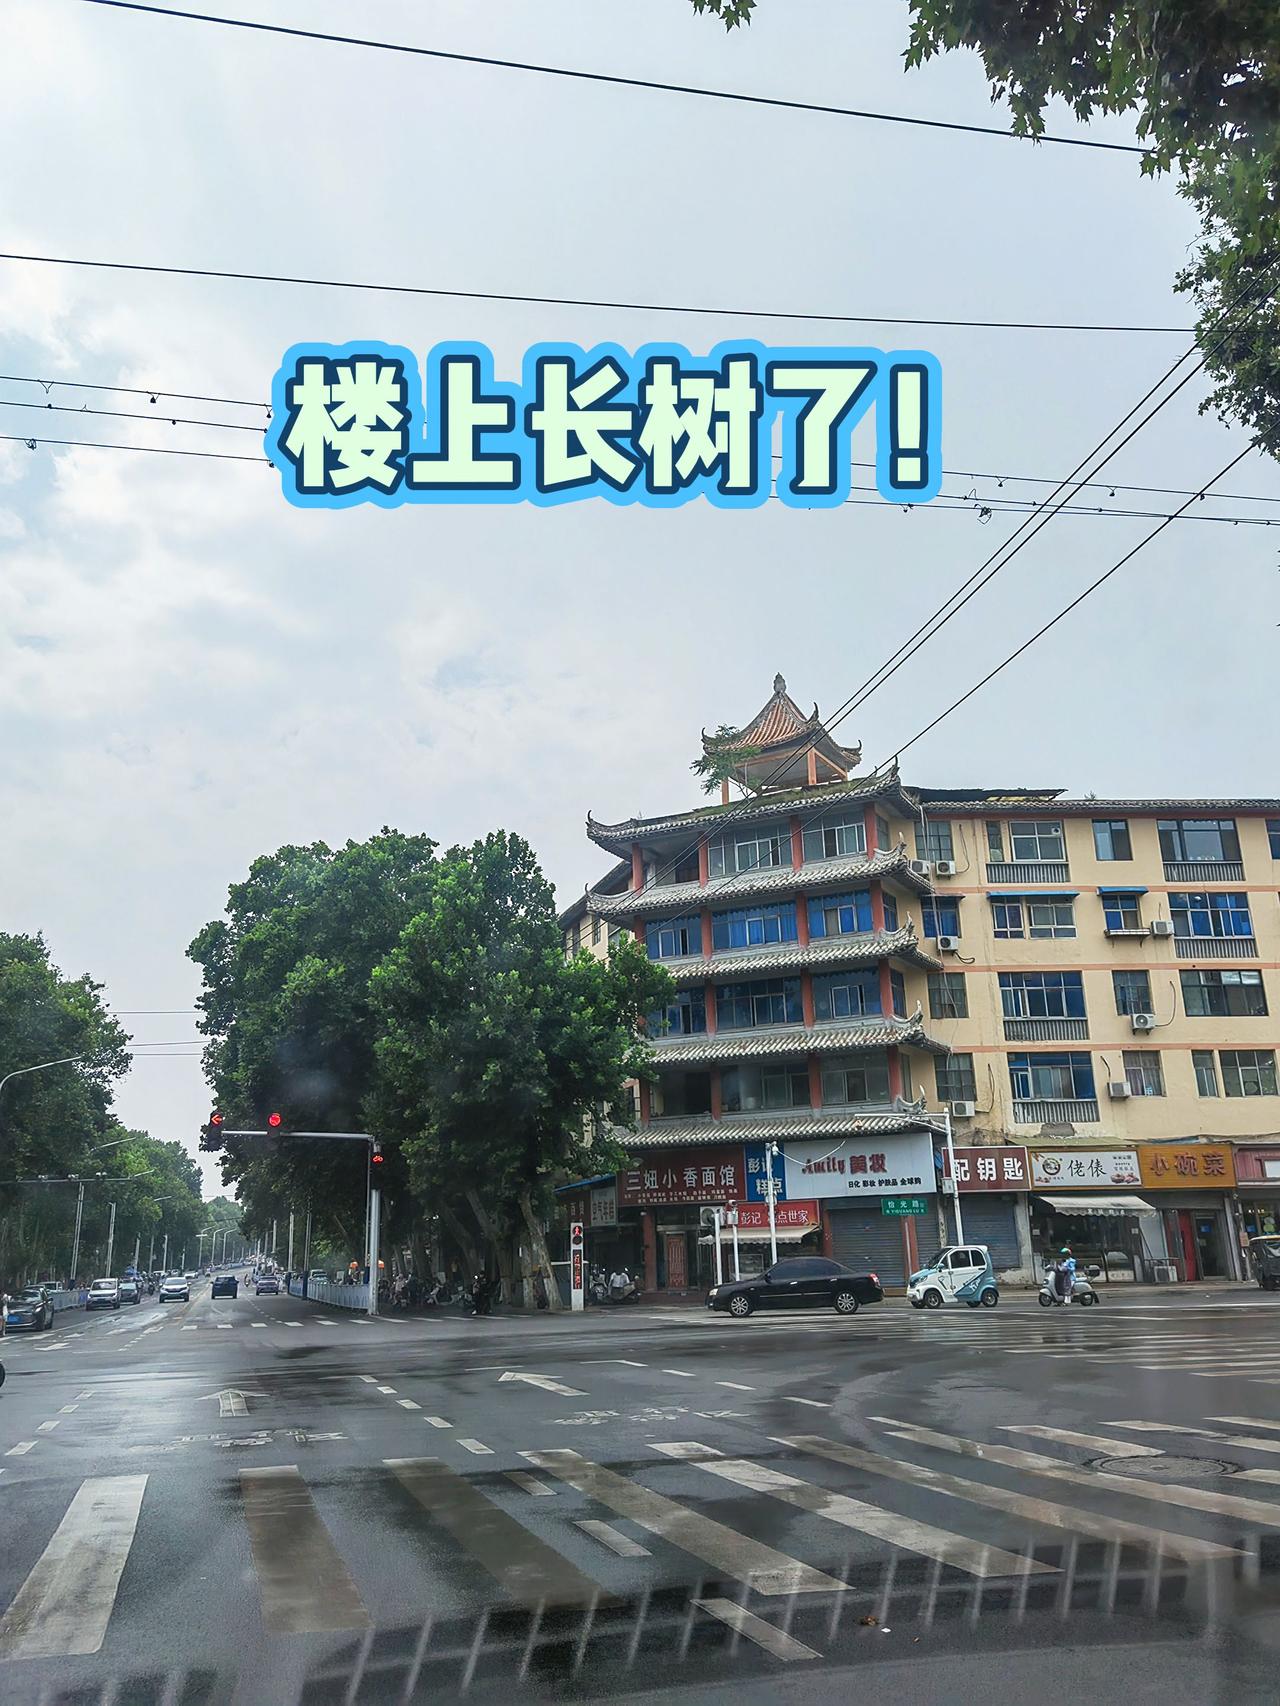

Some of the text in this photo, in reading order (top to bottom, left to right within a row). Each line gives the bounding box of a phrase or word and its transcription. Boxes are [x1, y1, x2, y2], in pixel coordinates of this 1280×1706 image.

[954, 1158, 1023, 1181] 配钥匙
[1151, 1152, 1226, 1176] 小碗菜
[626, 1165, 735, 1191] 三妞小香面馆
